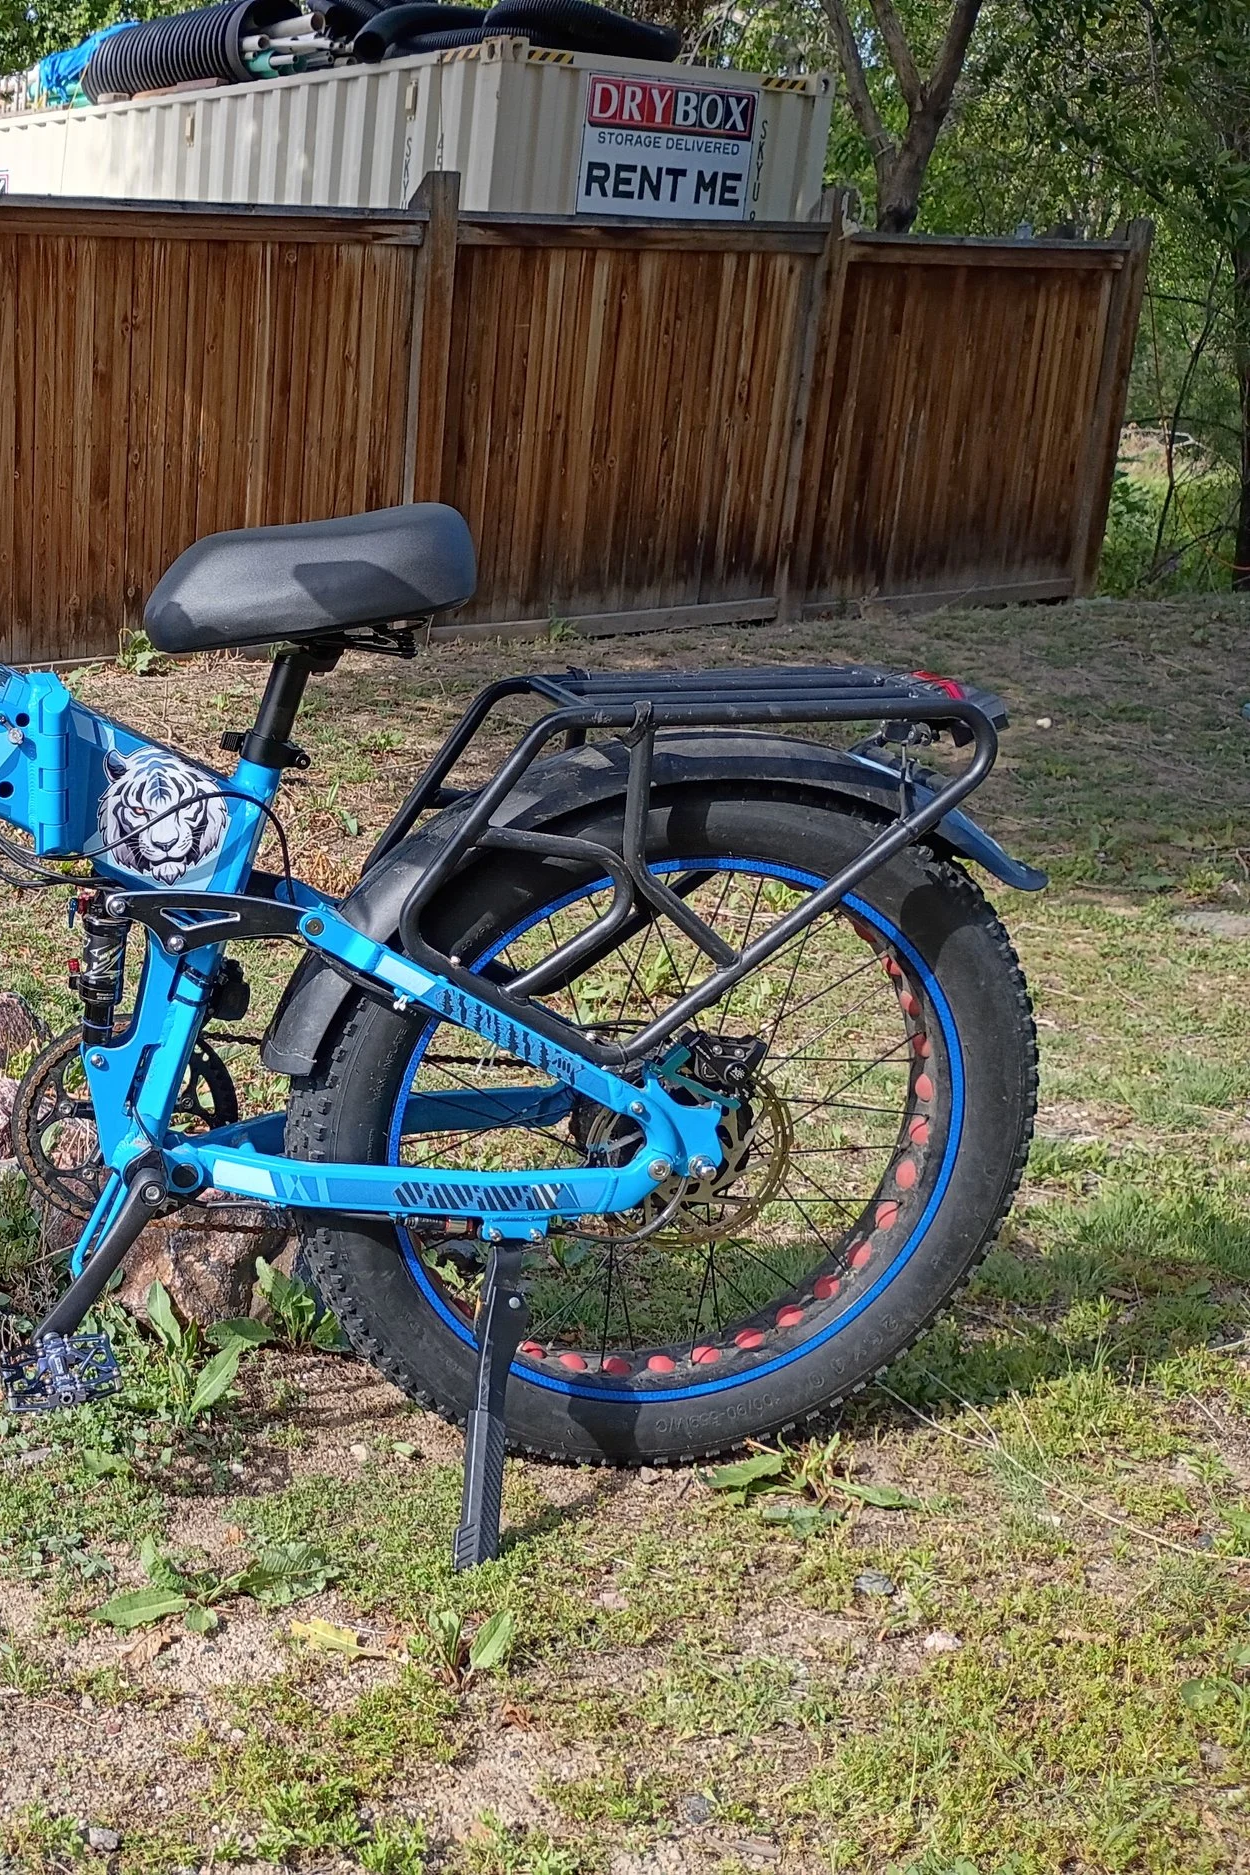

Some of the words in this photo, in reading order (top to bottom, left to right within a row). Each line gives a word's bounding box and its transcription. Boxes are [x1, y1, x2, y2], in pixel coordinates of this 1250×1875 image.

[592, 82, 748, 131] DRYBOX
[598, 131, 661, 149] STORAGE
[666, 137, 740, 155] DELIVERED
[753, 120, 768, 201] SKYU
[584, 161, 687, 203] RENT
[693, 170, 742, 207] ME
